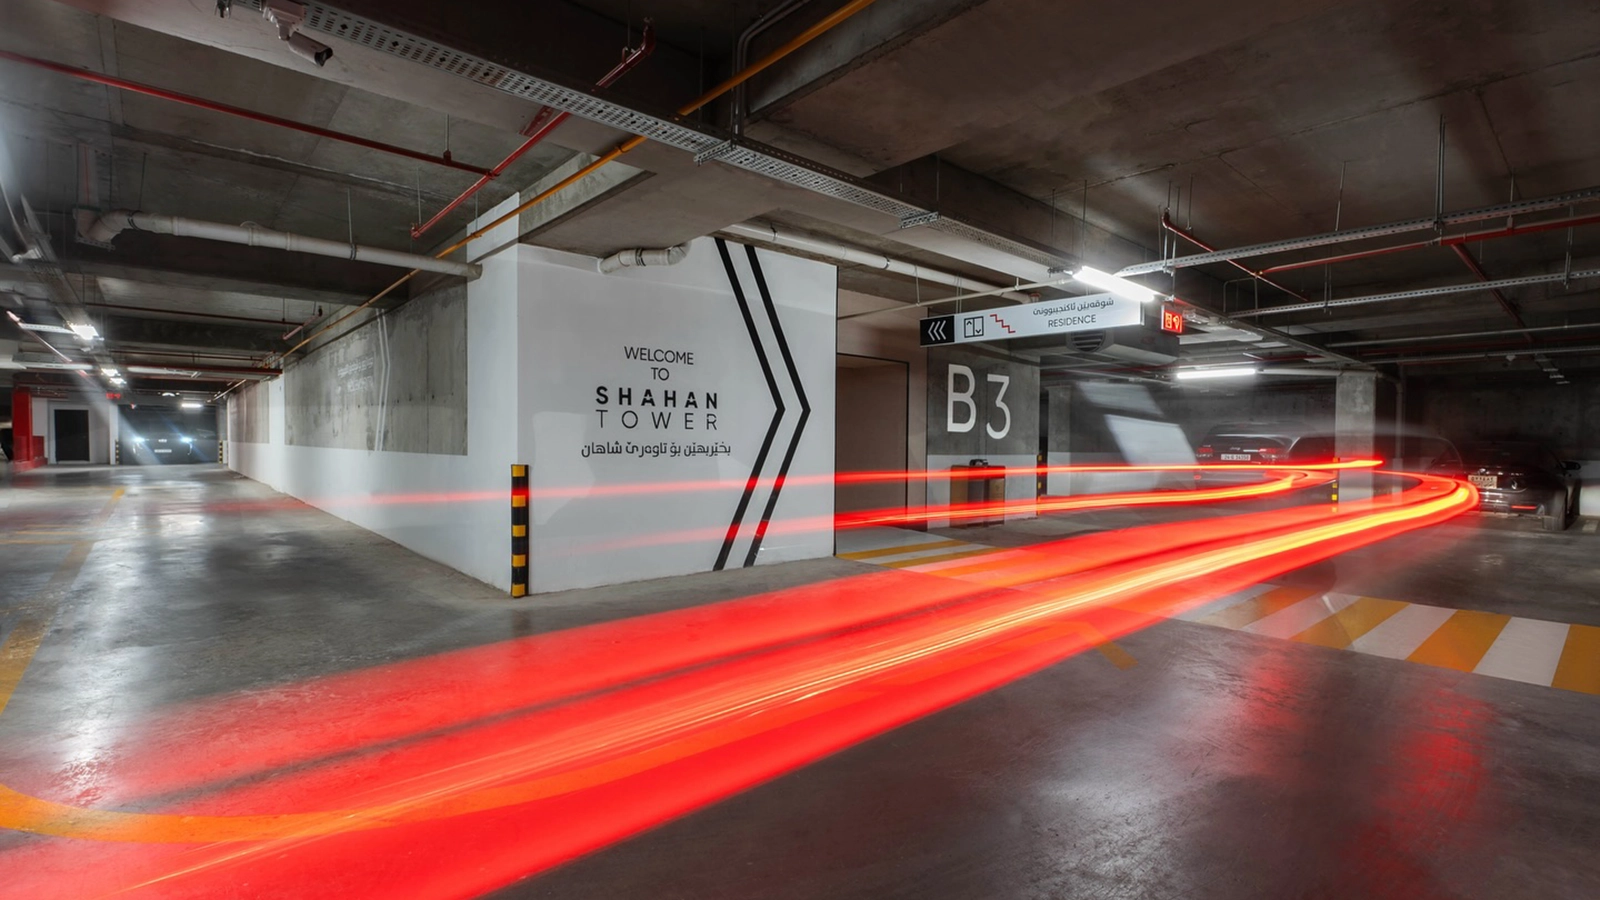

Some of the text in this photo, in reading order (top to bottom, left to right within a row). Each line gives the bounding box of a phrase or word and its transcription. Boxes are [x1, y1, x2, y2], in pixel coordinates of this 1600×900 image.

[1048, 314, 1096, 328] RESIDENCE
[624, 346, 694, 365] WELCOME
[651, 367, 670, 381] TO
[595, 386, 718, 409] SHAHAN
[595, 409, 718, 430] TOWER
